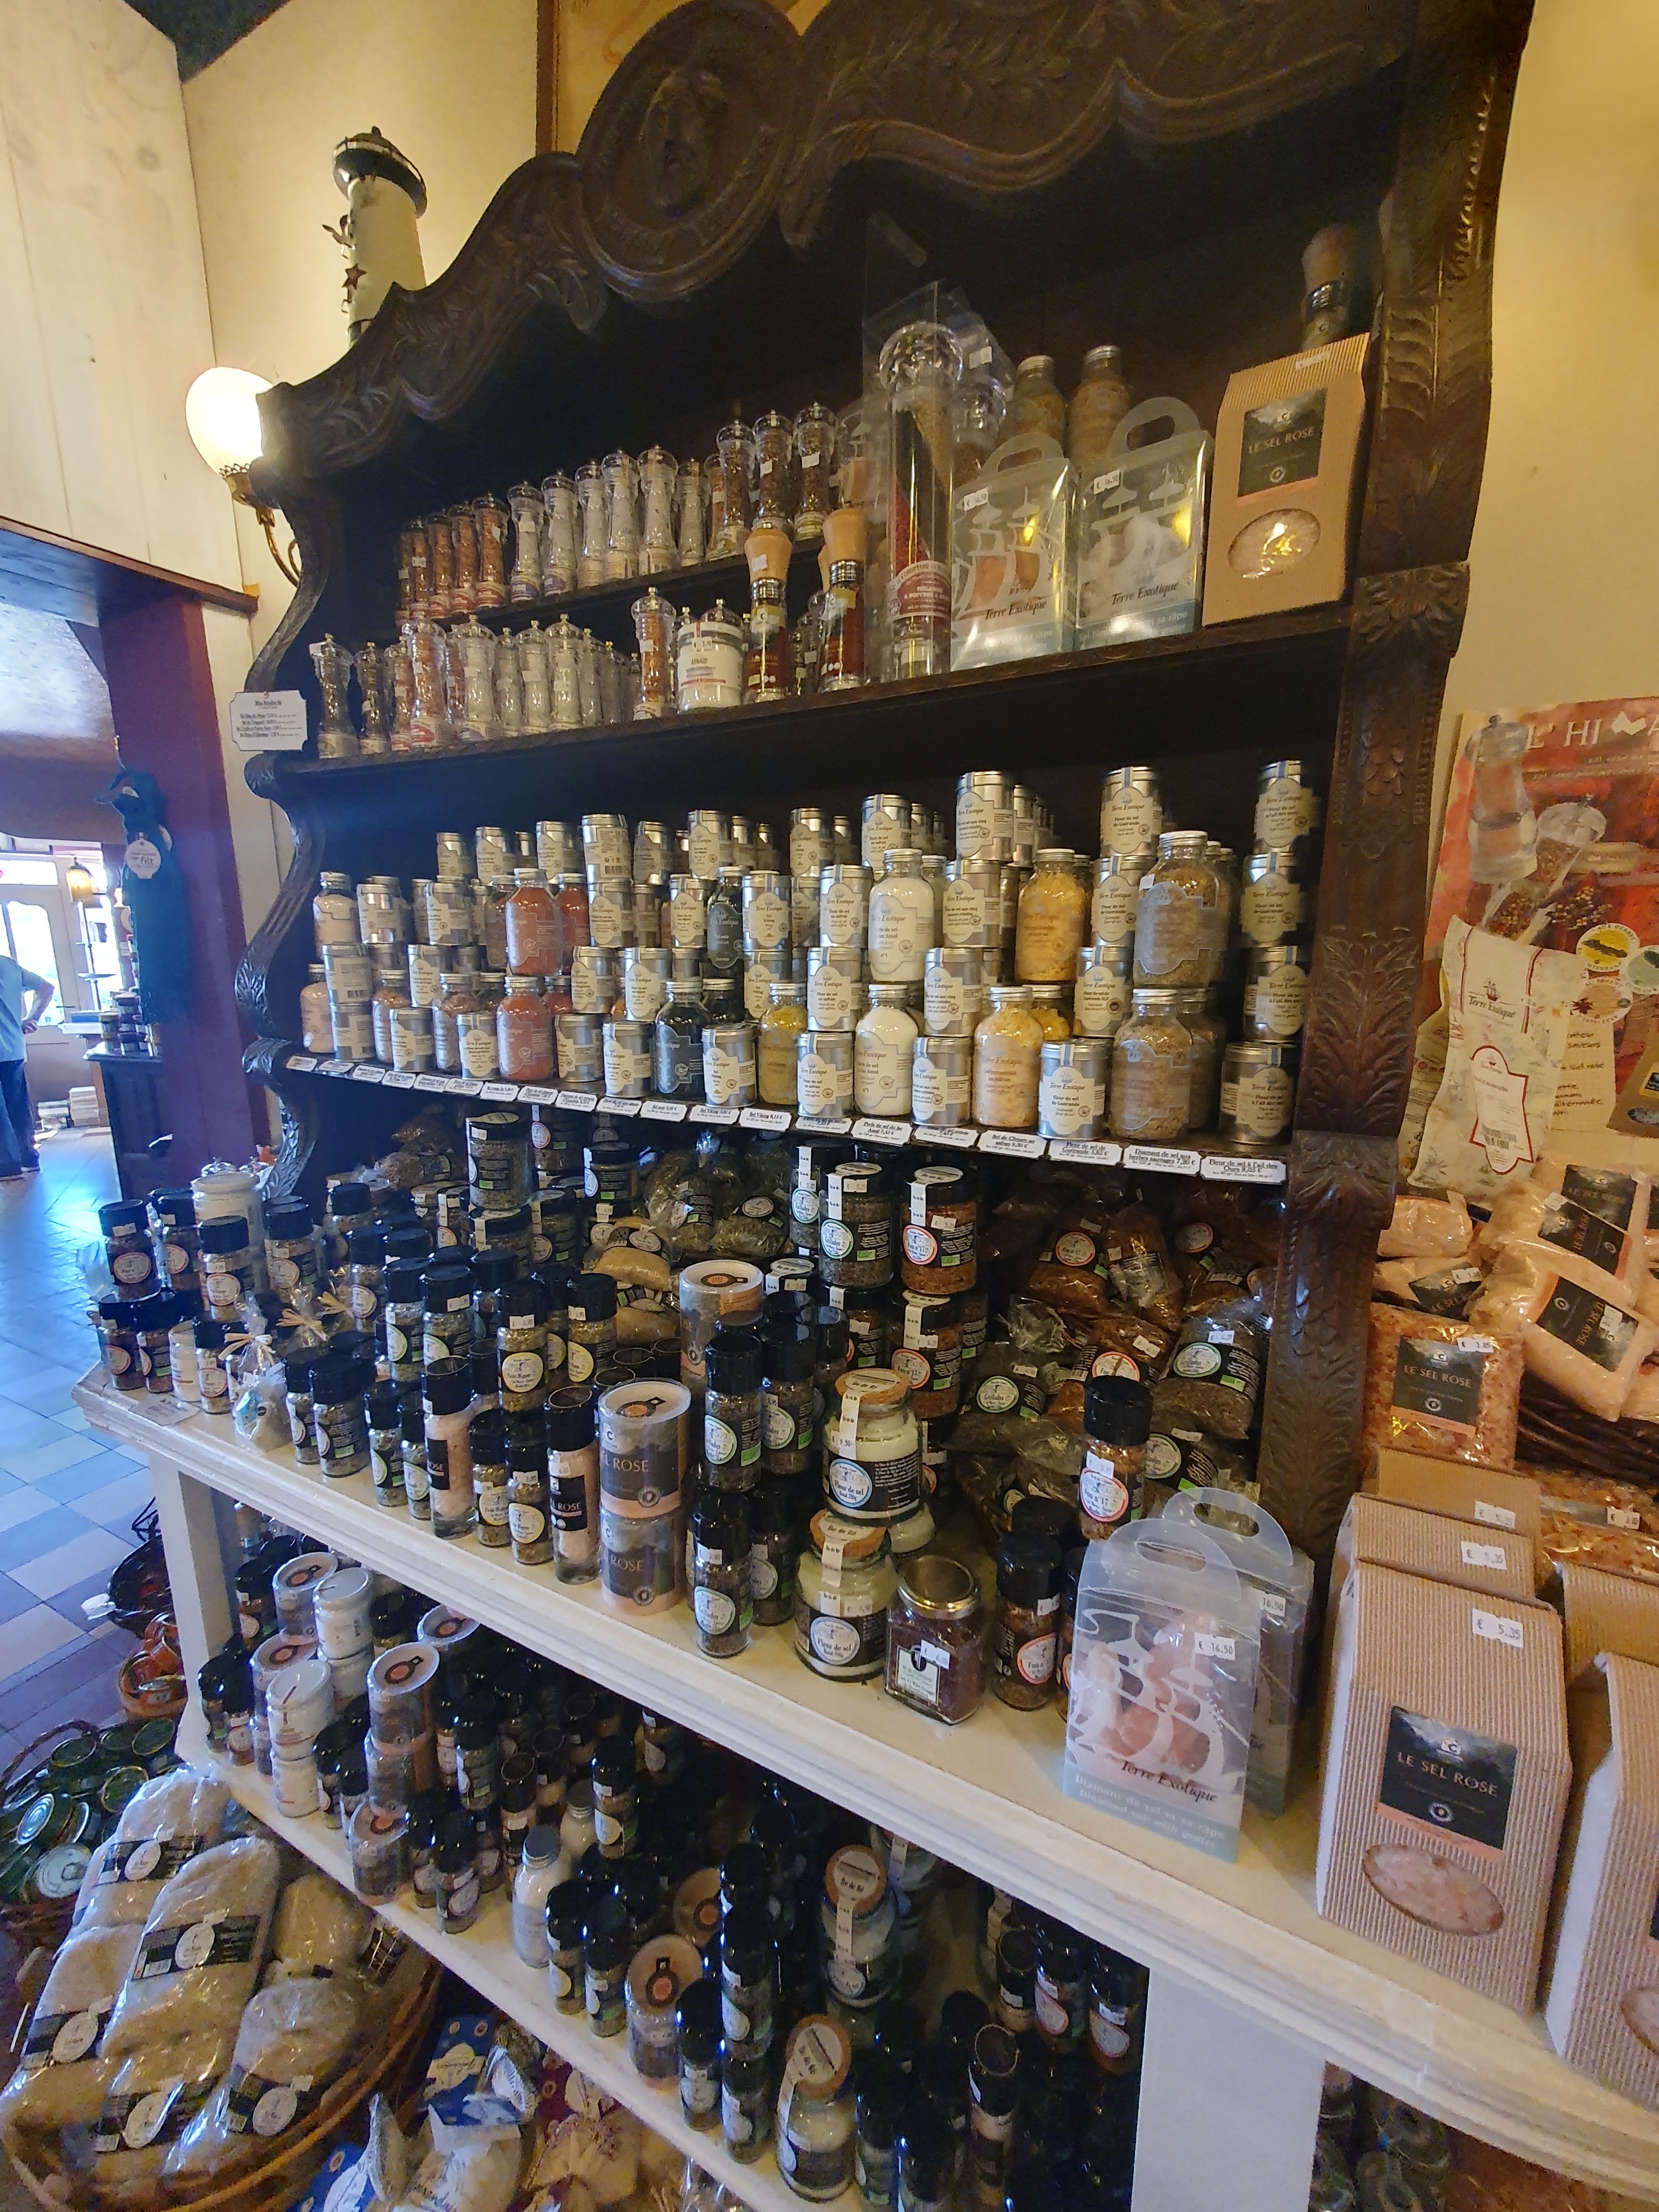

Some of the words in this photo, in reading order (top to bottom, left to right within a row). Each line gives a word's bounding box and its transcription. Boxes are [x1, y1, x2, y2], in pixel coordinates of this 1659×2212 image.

[1248, 444, 1260, 454] LE
[1265, 436, 1281, 448] SEL
[1286, 426, 1314, 444] ROSE
[1111, 591, 1134, 606] Terre
[1137, 582, 1179, 600] Exotique
[985, 607, 1006, 620] Terre
[1008, 600, 1047, 617] Exotique
[1468, 996, 1487, 1009] Terre
[1063, 1082, 1085, 1092] Exotique
[1135, 1148, 1160, 1157] Diamant
[1404, 1365, 1416, 1375] LE
[1419, 1369, 1437, 1380] SEL
[1442, 1372, 1472, 1388] ROSE
[613, 1457, 649, 1472] ROSE
[835, 1479, 846, 1491] Fleur
[558, 1502, 581, 1512] ROSE
[611, 1554, 644, 1571] ROSE
[1262, 1598, 1284, 1611] 16.50
[817, 1638, 832, 1650] Fleur
[1211, 1642, 1234, 1655] 16.50
[1396, 1751, 1415, 1767] LE
[1421, 1760, 1447, 1779] SEL
[1453, 1771, 1498, 1798] ROSE
[1157, 1773, 1218, 1803] Exotique
